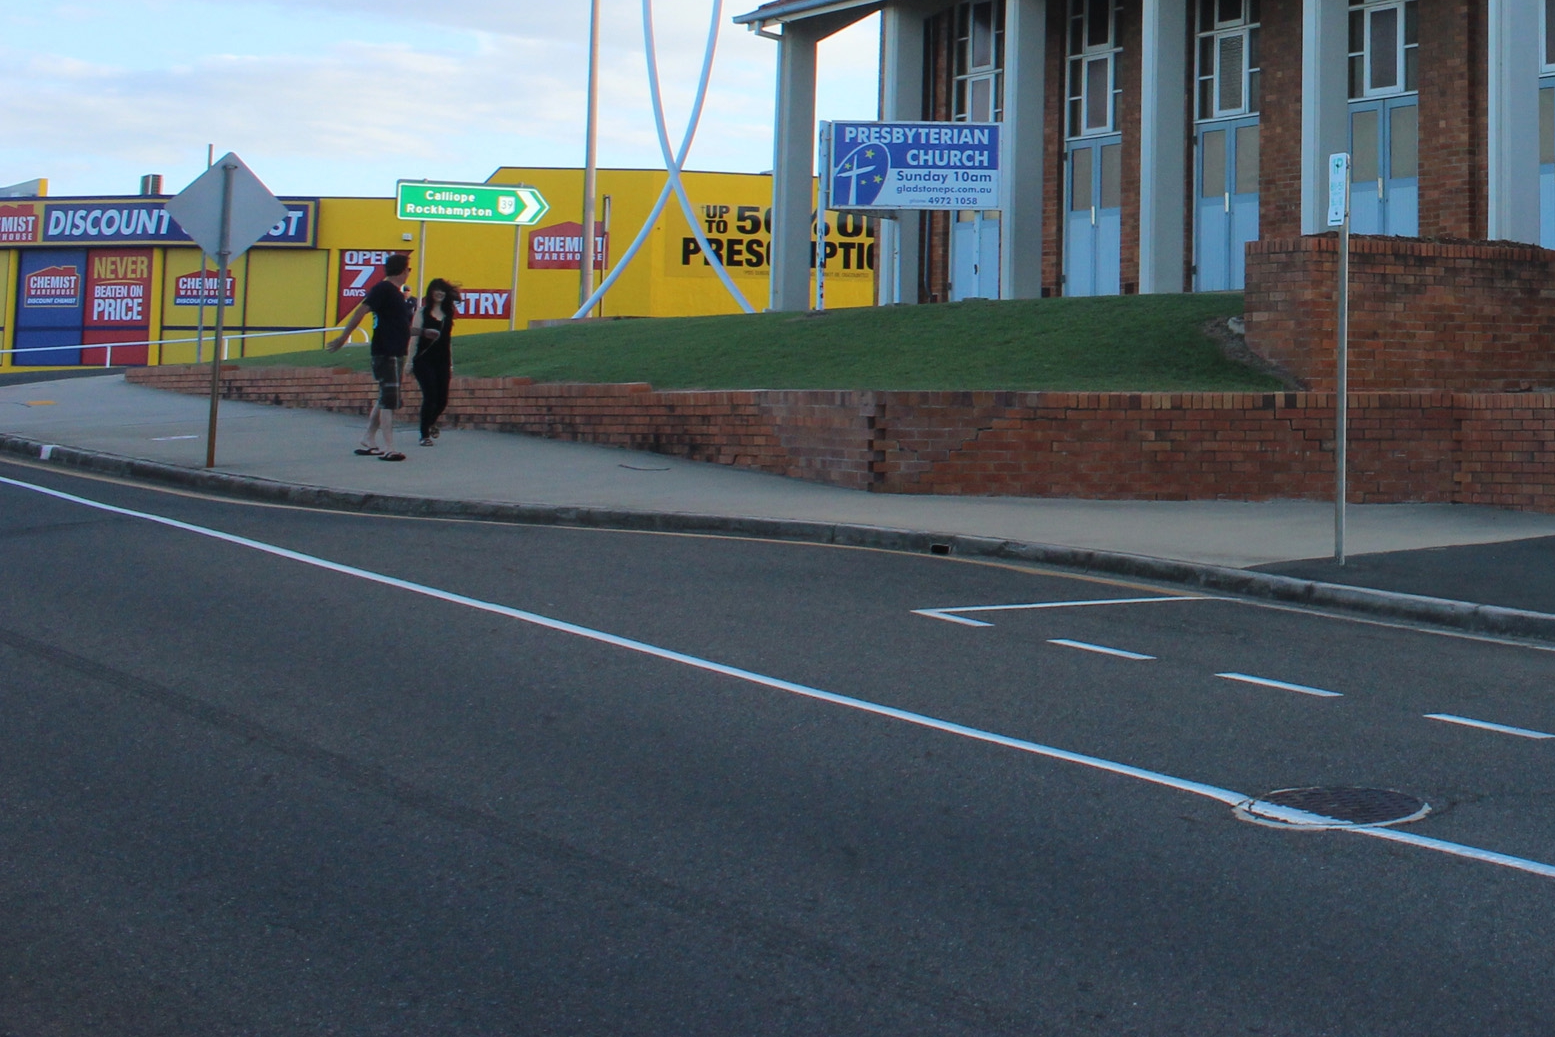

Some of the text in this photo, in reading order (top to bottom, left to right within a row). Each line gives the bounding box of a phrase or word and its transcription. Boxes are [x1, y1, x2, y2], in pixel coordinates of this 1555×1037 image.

[844, 126, 989, 145] PRESBYTERIAN
[906, 149, 989, 167] CHURCH
[896, 170, 992, 184] Sunday 10am
[425, 190, 476, 203] Calliope
[896, 185, 992, 194] gladstonepc.com.au
[928, 197, 951, 205] 4972
[955, 197, 978, 205] 1058
[406, 203, 493, 217] Rockhampton
[0, 216, 36, 233] MIST
[48, 210, 170, 235] DISCOUNT
[705, 219, 728, 234] TO
[533, 236, 603, 252] CHEMIT
[94, 256, 149, 279] NEVER
[30, 276, 77, 289] CHEMIST
[345, 265, 376, 288] 7
[94, 284, 143, 298] BEATEN ON
[343, 289, 367, 297] DAYS
[93, 298, 143, 321] PRICE
